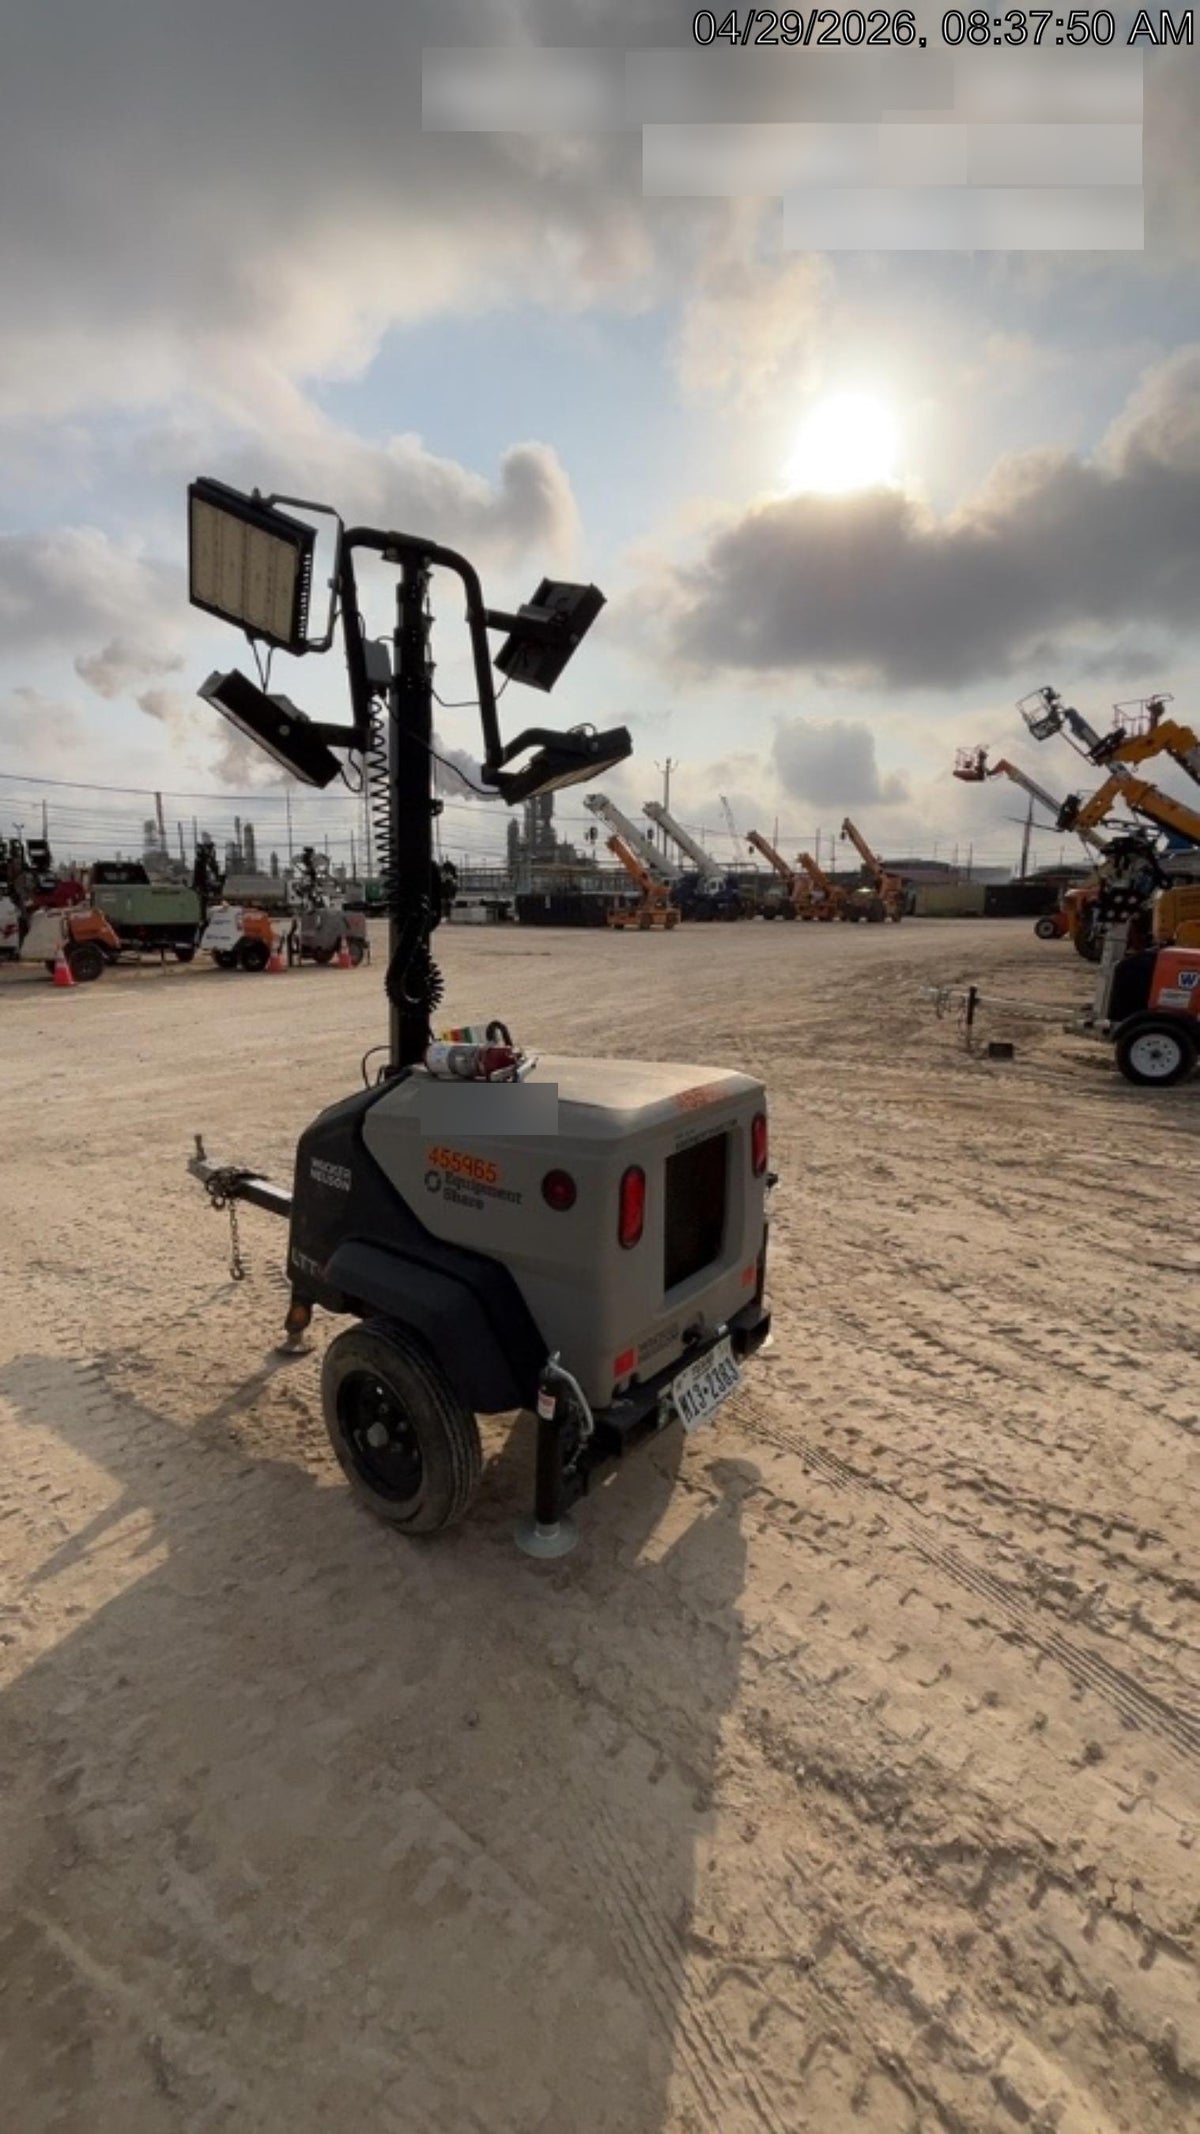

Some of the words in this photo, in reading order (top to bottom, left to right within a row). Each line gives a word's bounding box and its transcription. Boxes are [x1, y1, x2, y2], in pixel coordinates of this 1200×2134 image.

[428, 1146, 498, 1183] 455965
[443, 1187, 486, 1211] Share
[444, 1171, 523, 1205] Equipment
